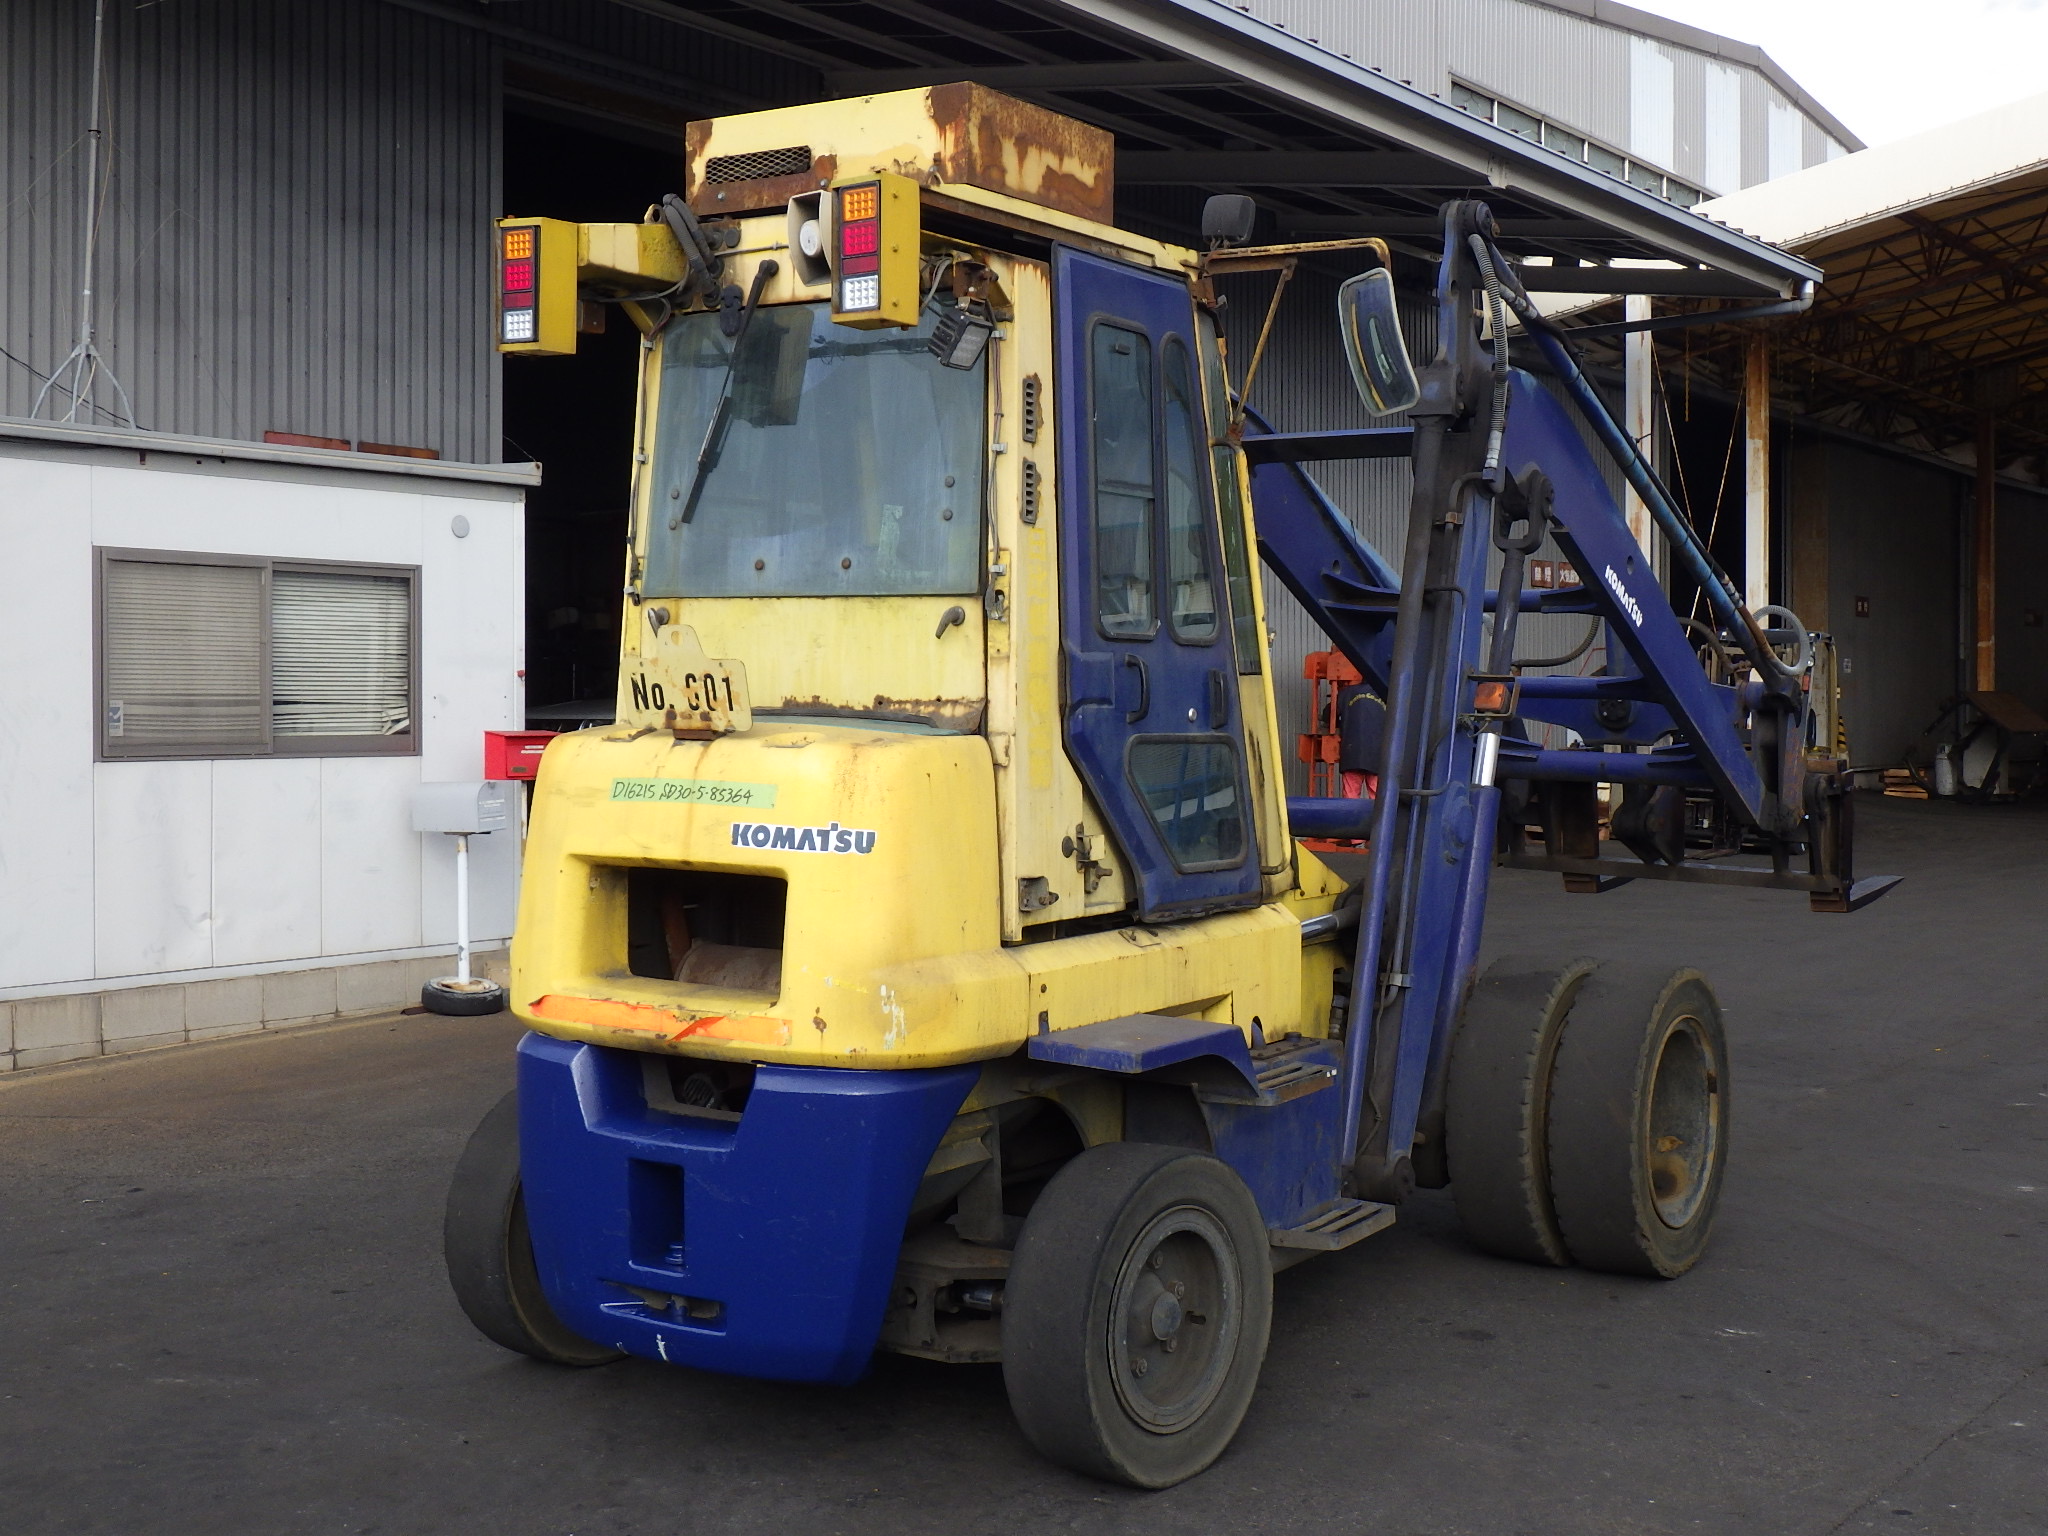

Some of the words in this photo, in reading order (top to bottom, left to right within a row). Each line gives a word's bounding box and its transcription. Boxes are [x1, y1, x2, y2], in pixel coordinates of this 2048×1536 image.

[1605, 564, 1643, 627] KOMATSU
[630, 672, 675, 711] No.
[612, 782, 656, 799] D16215
[731, 823, 876, 854] KOMATSU
